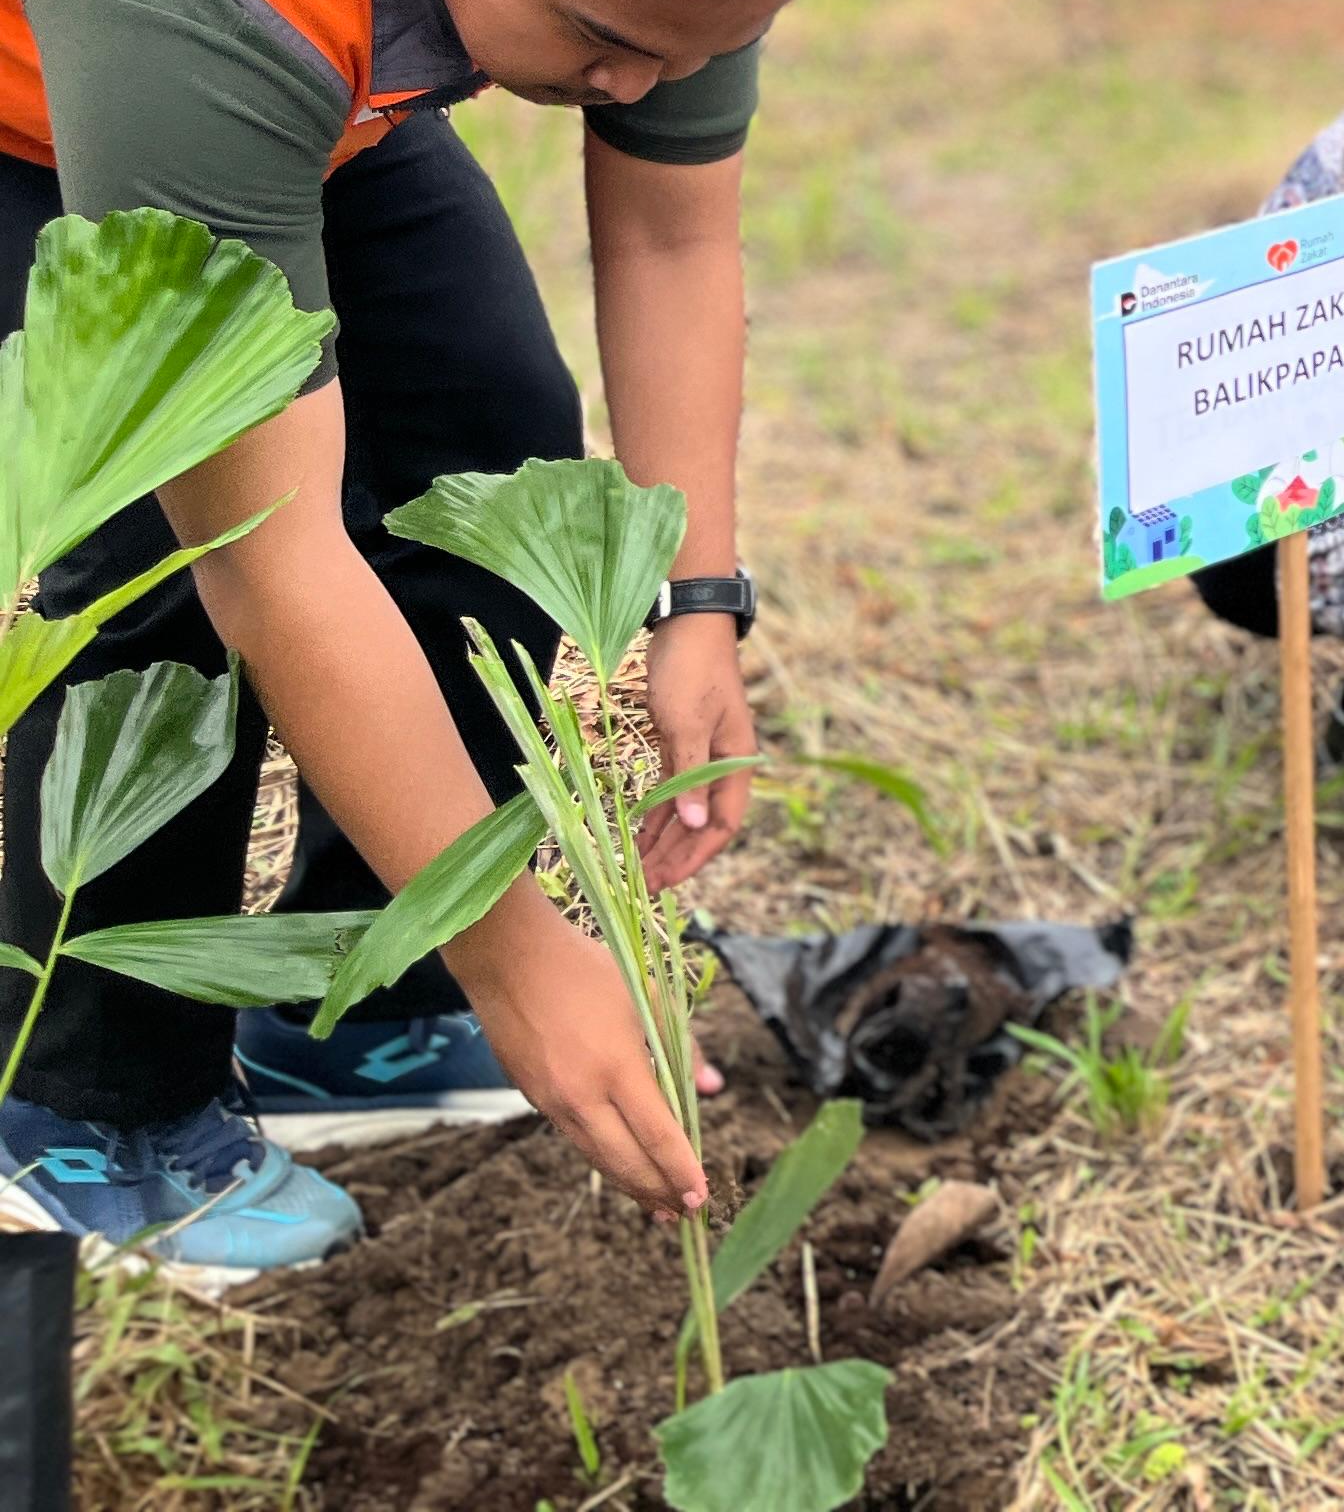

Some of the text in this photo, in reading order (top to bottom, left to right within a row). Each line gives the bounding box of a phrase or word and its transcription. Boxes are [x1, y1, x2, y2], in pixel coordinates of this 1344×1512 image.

[1300, 231, 1335, 248] Rumah
[1141, 273, 1199, 298] Danantara
[1141, 288, 1196, 312] Indonesia
[1177, 310, 1286, 368] RUMAH
